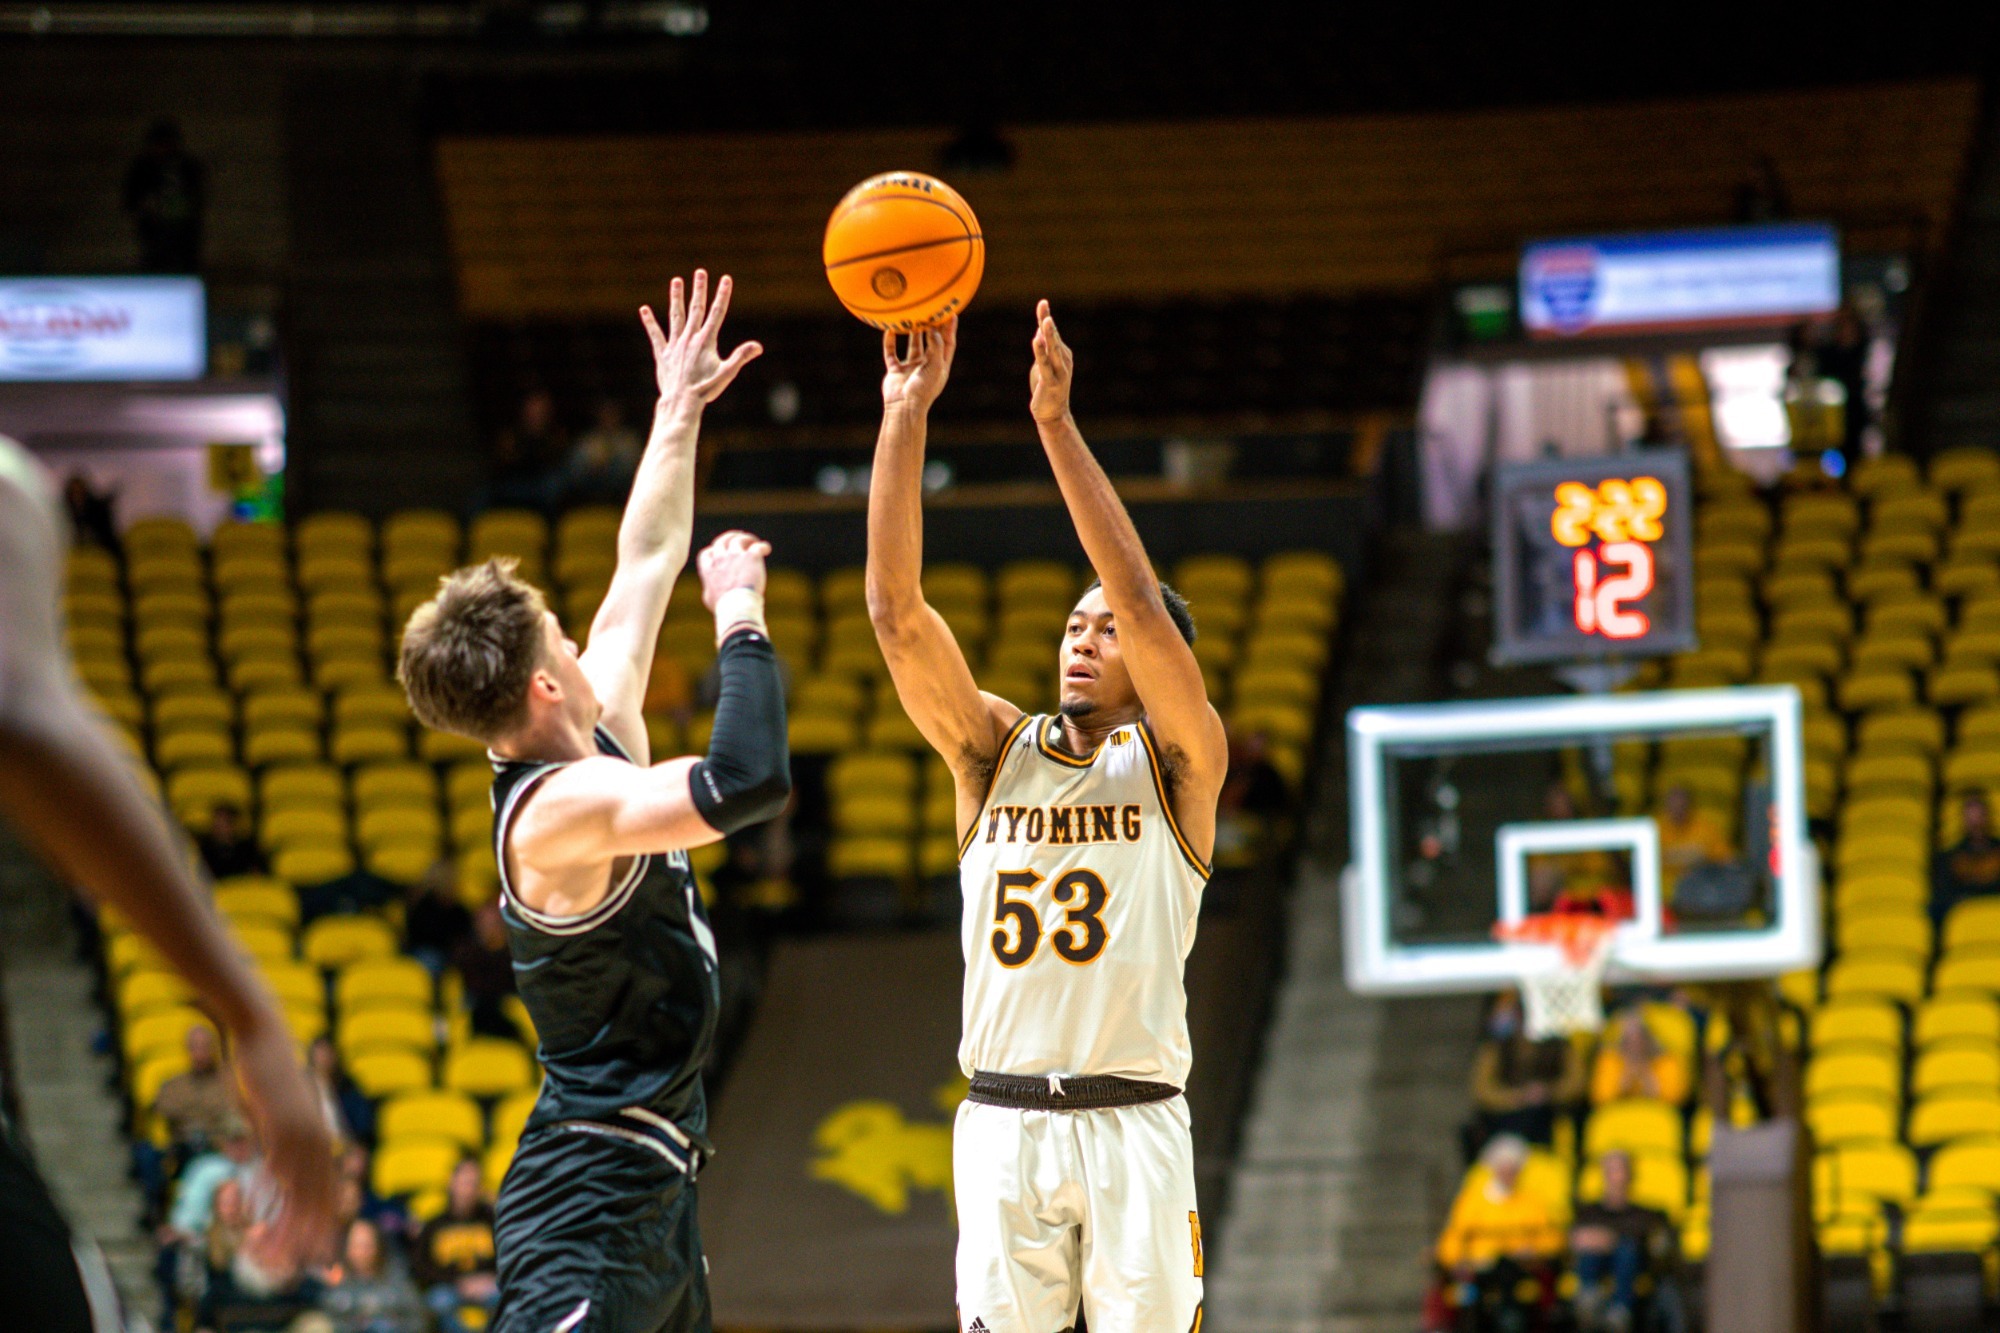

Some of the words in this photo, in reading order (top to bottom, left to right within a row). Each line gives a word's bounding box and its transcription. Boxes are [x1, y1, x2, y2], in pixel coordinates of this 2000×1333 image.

[1573, 539, 1654, 640] 12
[986, 804, 1141, 844] WYOMING
[990, 867, 1112, 969] 53
